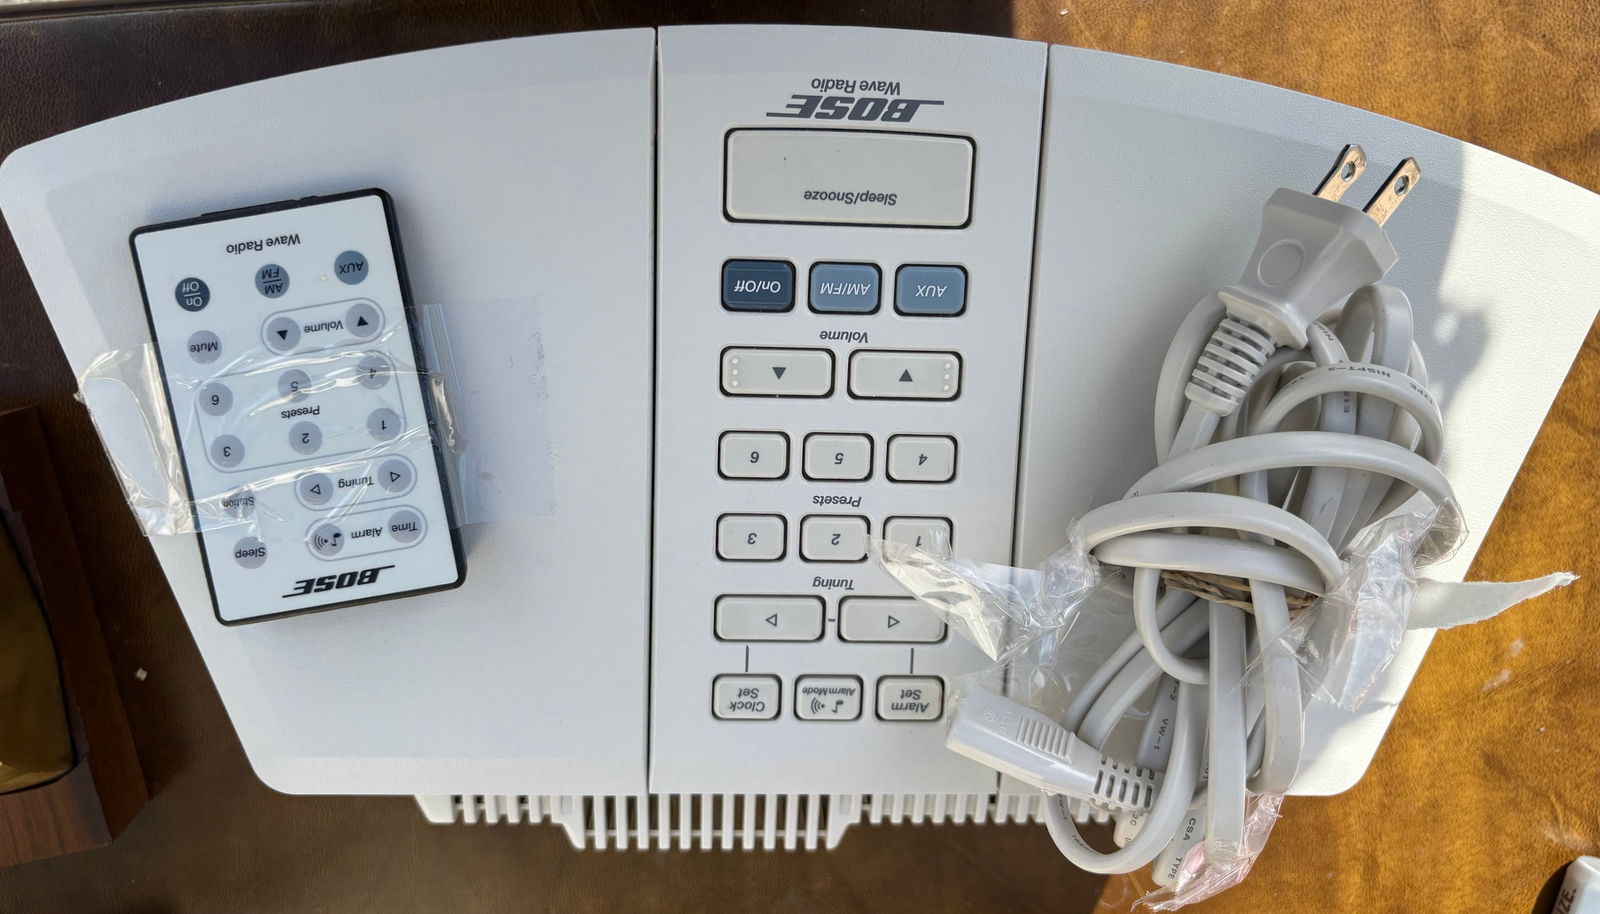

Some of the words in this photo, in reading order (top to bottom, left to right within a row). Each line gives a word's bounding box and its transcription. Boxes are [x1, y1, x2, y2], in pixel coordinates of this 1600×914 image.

[811, 78, 855, 93] Radio
[859, 81, 901, 95] Wave
[766, 94, 945, 123] BOSE
[803, 189, 898, 206] Sleep/Snooze
[226, 239, 263, 254] Radio
[266, 233, 300, 247] Wave
[262, 268, 280, 279] FM
[339, 261, 364, 275] AUX
[181, 281, 200, 292] Off
[264, 282, 283, 294] AM
[734, 280, 781, 293] On/Off
[820, 282, 871, 295] AM/FM
[915, 284, 947, 298] AUX
[186, 295, 203, 307] On
[303, 319, 344, 334] Volume
[819, 330, 869, 344] Volume
[190, 340, 218, 353] Mute
[291, 380, 299, 393] 5
[211, 394, 220, 406] 6
[281, 405, 320, 419] Presets
[381, 419, 387, 431] 1
[301, 433, 309, 444] 2
[223, 446, 231, 457] 3
[750, 451, 760, 464] 6
[834, 453, 844, 465] 5
[918, 454, 928, 466] 4
[338, 474, 375, 490] Tuning
[223, 495, 255, 509] Station
[812, 494, 862, 508] Presets
[391, 520, 418, 532] Time
[351, 526, 383, 540] Alarm
[747, 532, 757, 544] 3
[831, 533, 841, 545] 2
[915, 535, 922, 547] 1
[235, 546, 266, 560] Sleep
[282, 565, 396, 598] BOSE
[812, 576, 855, 590] Tuning
[737, 687, 760, 699] Set
[802, 686, 827, 695] Mode
[828, 687, 856, 697] Alarm
[900, 688, 921, 700] Set
[729, 701, 766, 713] Clock
[891, 701, 929, 713] Alarm
[1183, 817, 1197, 841] CSA
[1167, 857, 1184, 880] TYPE
